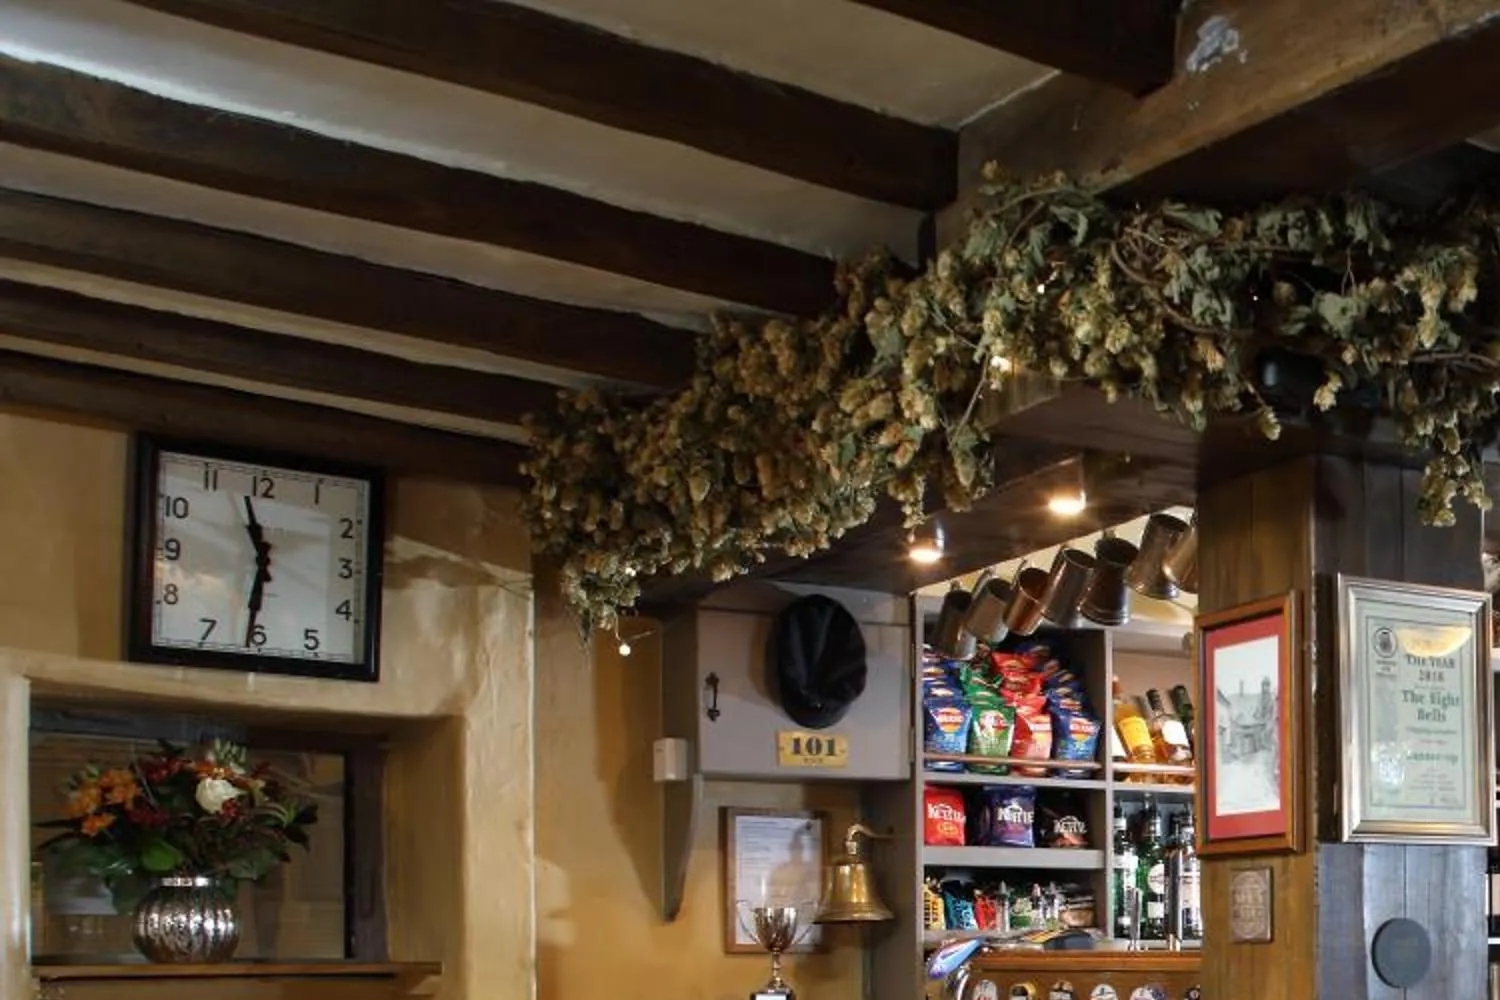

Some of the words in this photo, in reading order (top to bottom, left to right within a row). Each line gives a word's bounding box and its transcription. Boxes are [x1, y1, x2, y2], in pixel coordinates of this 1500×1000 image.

[204, 469, 218, 491] 11
[252, 476, 275, 499] 12
[314, 483, 321, 504] 1
[165, 496, 190, 519] 10
[338, 518, 354, 539] 2
[164, 538, 181, 561] 9
[337, 557, 353, 579] 3
[163, 583, 179, 605] 8
[335, 599, 352, 621] 4
[199, 618, 217, 641] 7
[252, 625, 267, 646] 6
[303, 629, 320, 650] 5
[1402, 689, 1425, 703] The
[1430, 692, 1460, 710] Eight
[1418, 708, 1446, 722] Bells
[792, 736, 837, 756] 101
